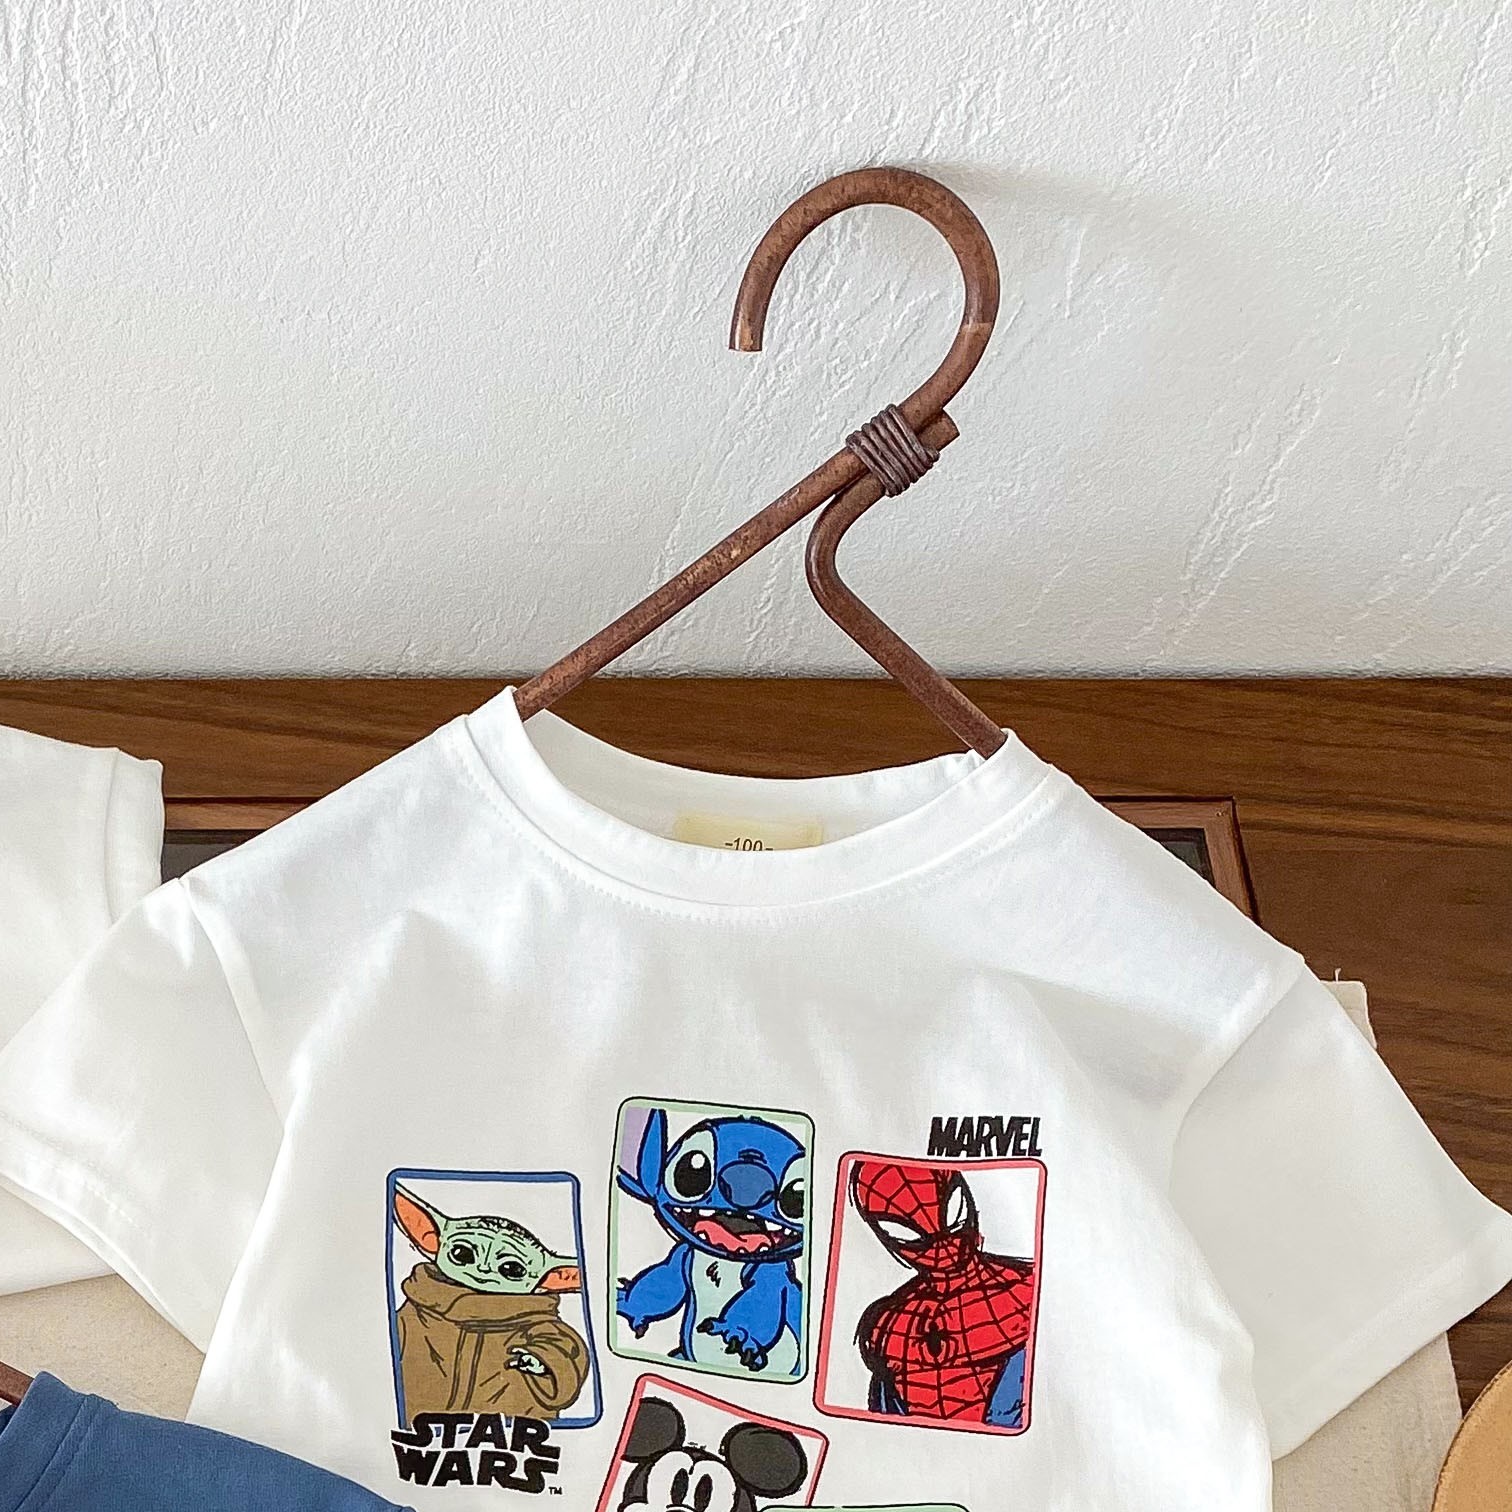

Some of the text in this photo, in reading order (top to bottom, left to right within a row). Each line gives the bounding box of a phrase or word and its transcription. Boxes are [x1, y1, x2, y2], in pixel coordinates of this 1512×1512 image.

[927, 1115, 1043, 1157] MARVEL
[390, 1412, 561, 1460] STAR
[391, 1442, 559, 1494] WARS
